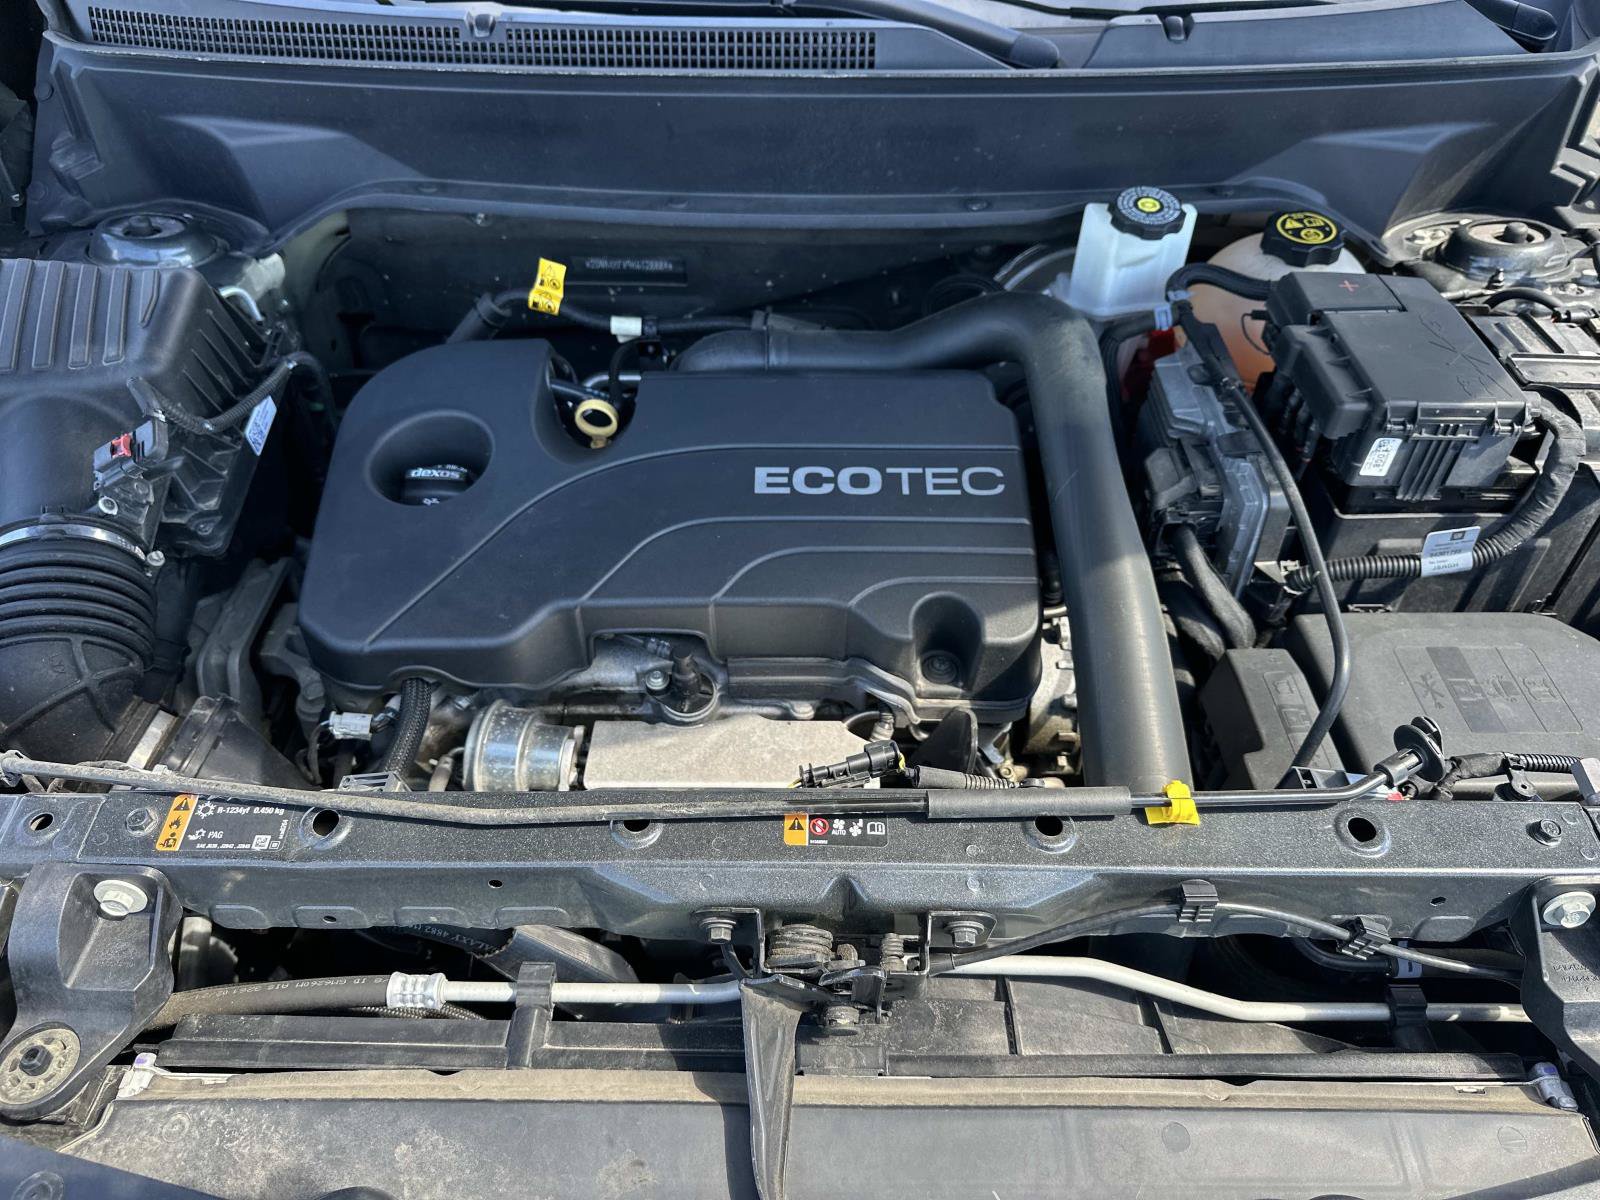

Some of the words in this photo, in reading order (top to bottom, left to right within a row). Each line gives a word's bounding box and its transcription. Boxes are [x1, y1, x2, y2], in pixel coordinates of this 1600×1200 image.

[410, 467, 460, 479] dexos
[754, 466, 1006, 496] ECOTEC
[216, 806, 250, 816] R-1234yf
[253, 806, 273, 815] 0.450
[274, 807, 285, 815] kg
[207, 831, 224, 839] PAG
